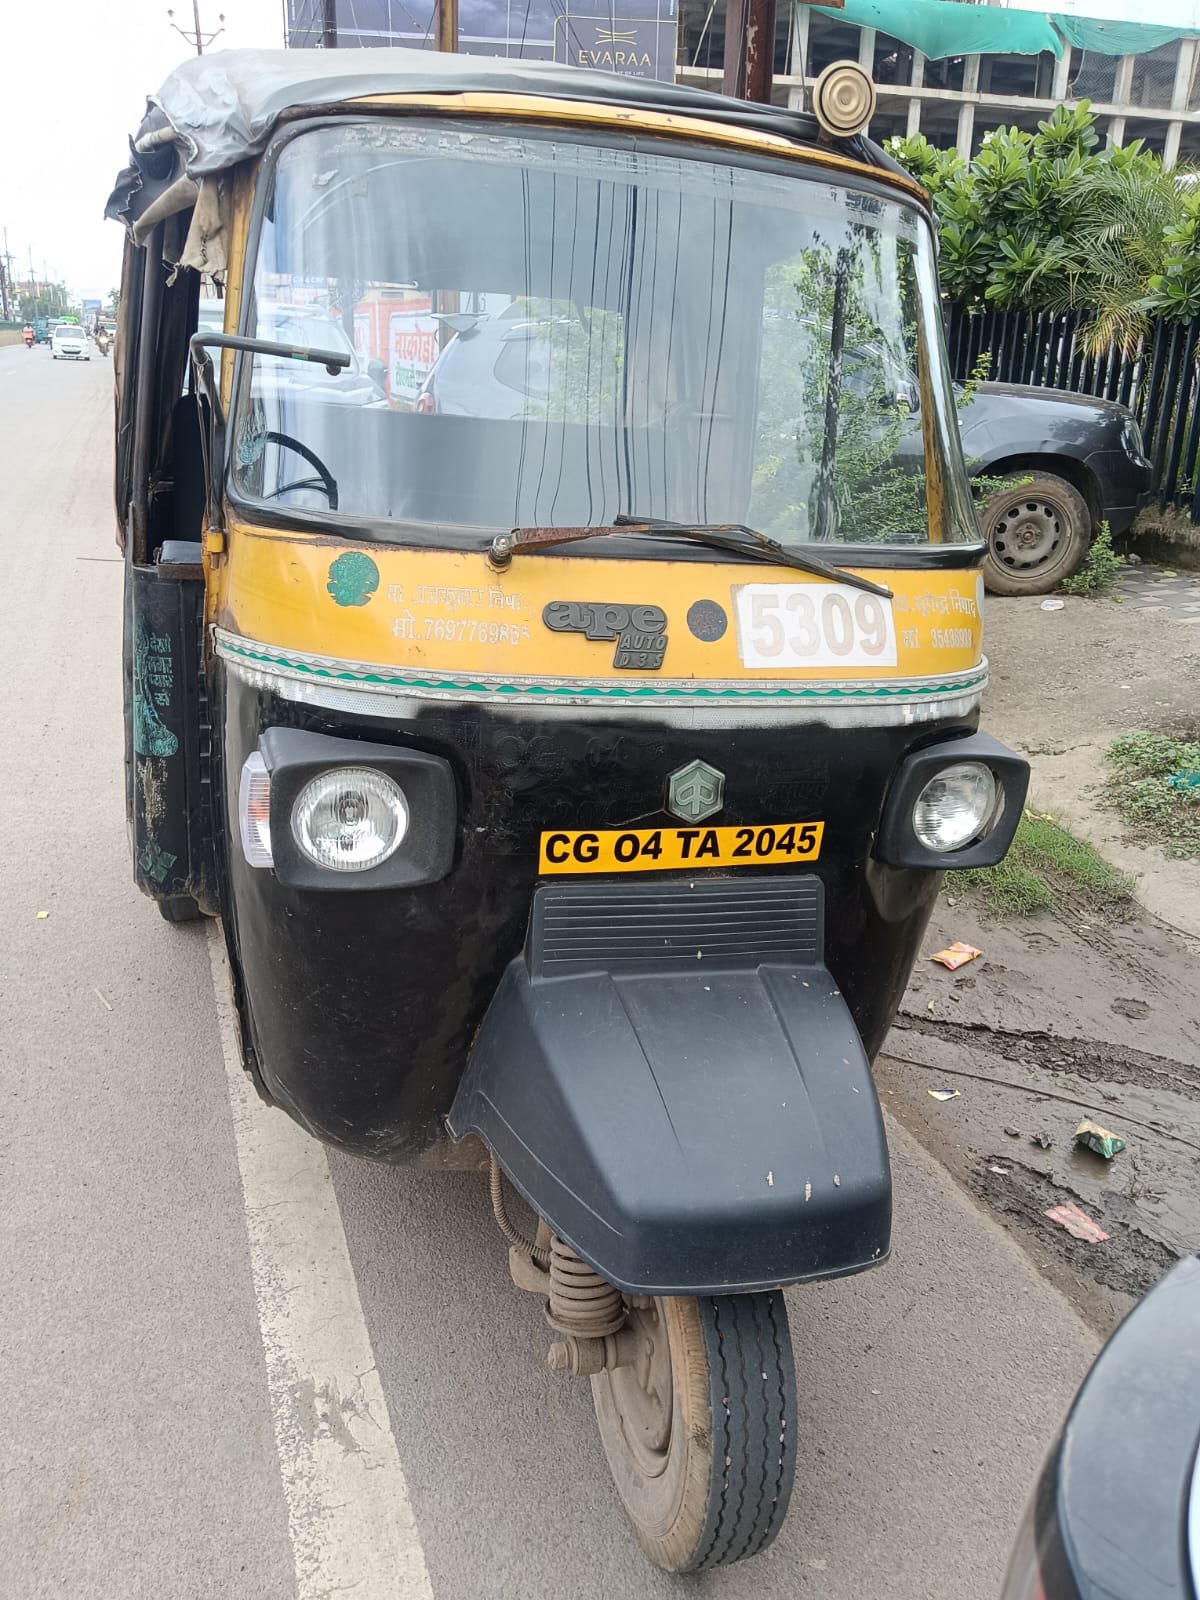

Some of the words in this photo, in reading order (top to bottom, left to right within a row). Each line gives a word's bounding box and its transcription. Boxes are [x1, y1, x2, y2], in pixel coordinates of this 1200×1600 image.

[579, 50, 651, 67] EVARAA
[547, 602, 665, 637] ape
[752, 592, 887, 657] 5309
[620, 634, 666, 650] AUTO
[545, 833, 599, 864] CG
[676, 830, 720, 859] TA
[732, 825, 817, 857] 2045
